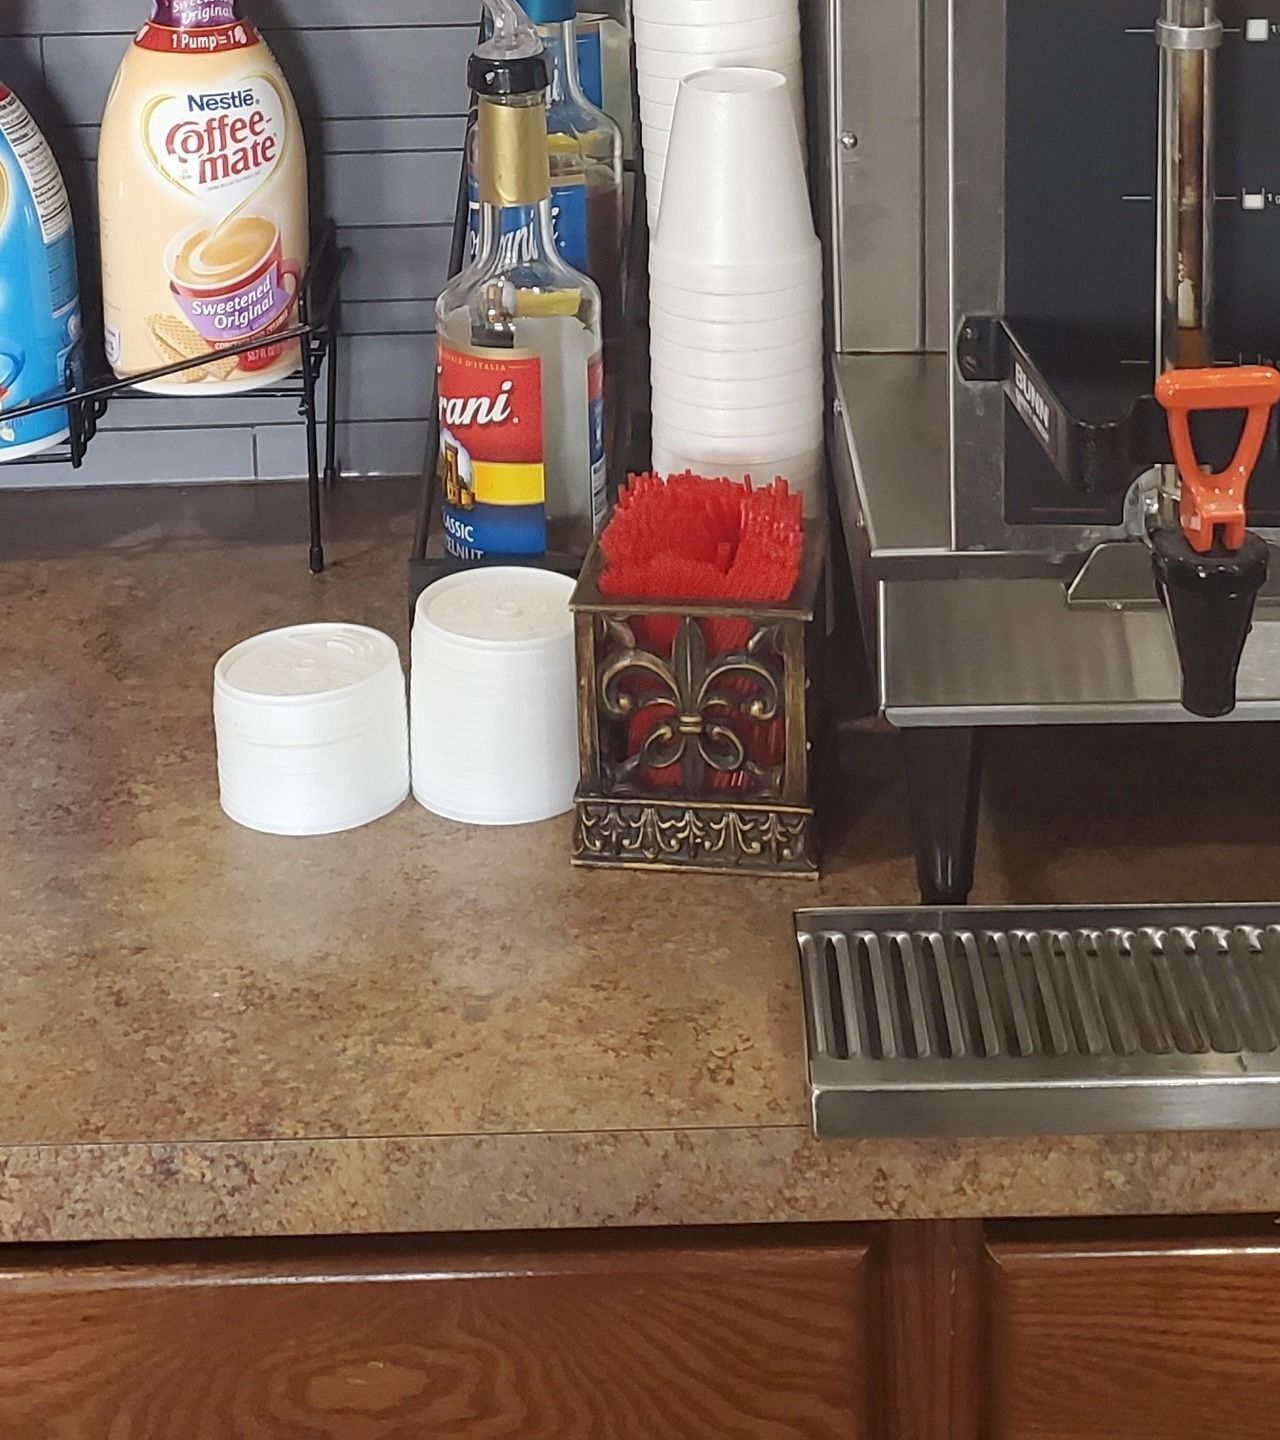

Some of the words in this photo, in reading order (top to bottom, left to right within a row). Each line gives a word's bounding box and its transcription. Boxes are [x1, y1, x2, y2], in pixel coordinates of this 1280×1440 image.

[181, 33, 217, 51] Pump
[198, 135, 277, 185] mate
[192, 274, 271, 315] Sweetened
[214, 290, 274, 330] Original
[438, 380, 512, 426] rani
[1015, 361, 1049, 429] BUNN
[447, 535, 485, 560] ELNUT
